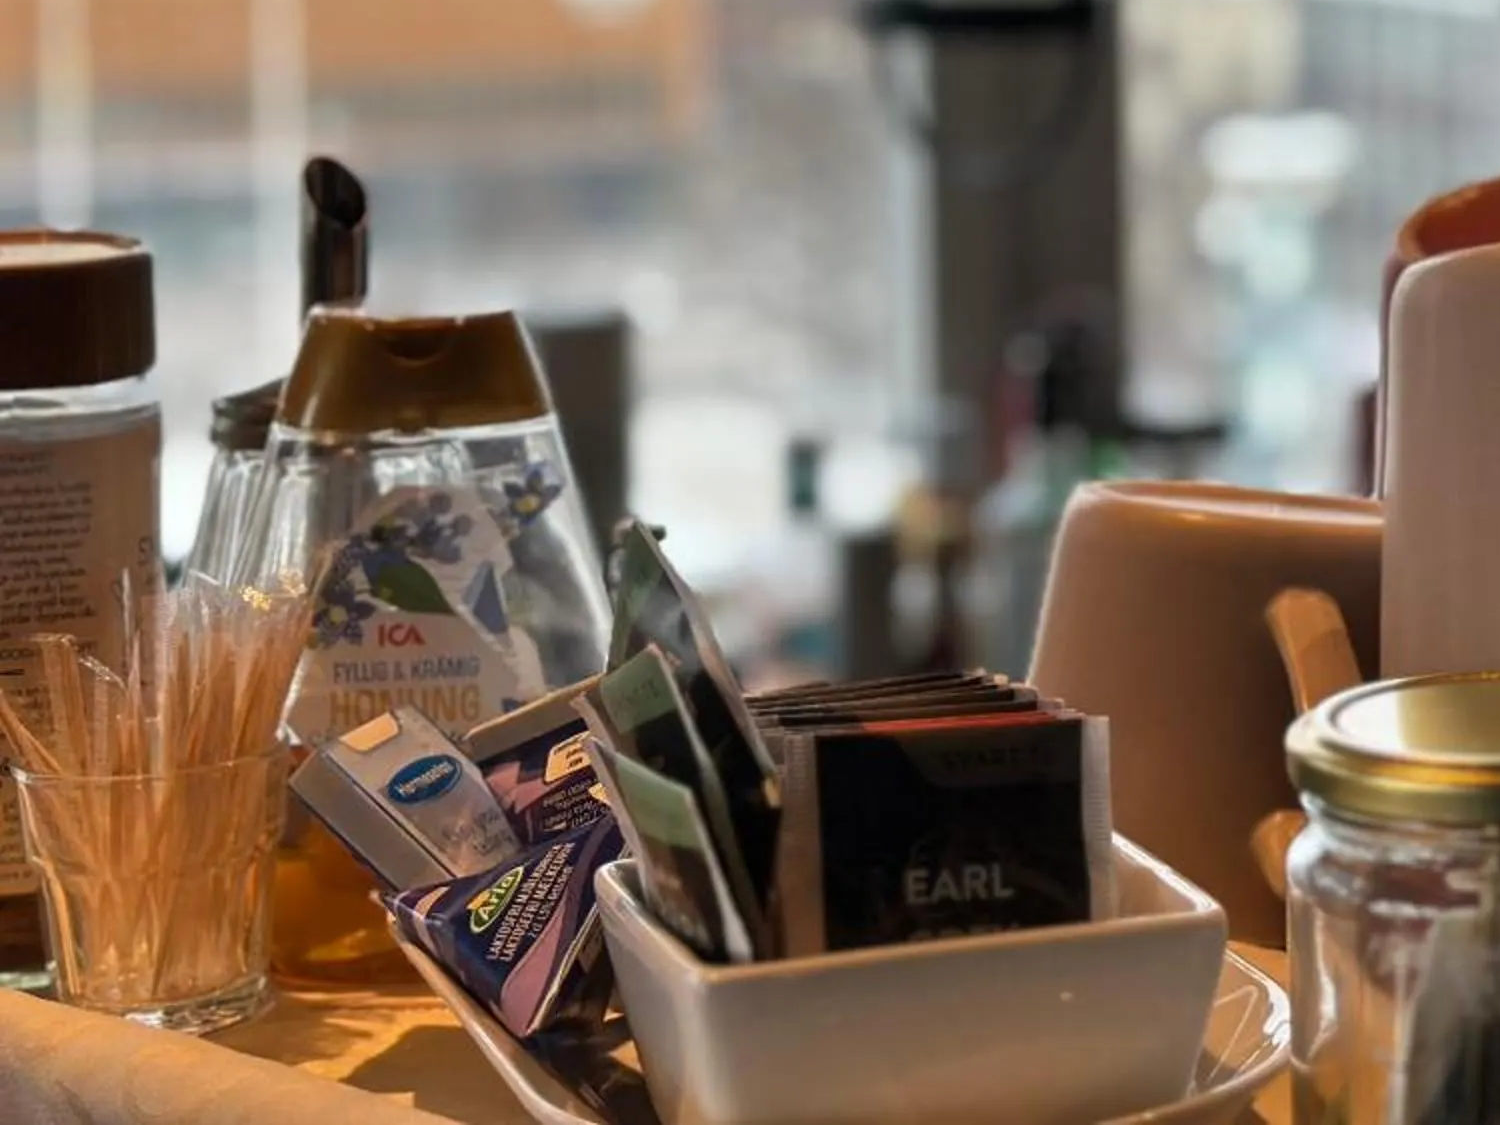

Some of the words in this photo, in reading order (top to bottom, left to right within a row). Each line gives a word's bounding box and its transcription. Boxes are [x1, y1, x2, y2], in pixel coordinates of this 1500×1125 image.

[378, 622, 426, 647] ICA
[475, 873, 514, 921] Arla
[903, 861, 1014, 905] EARL
